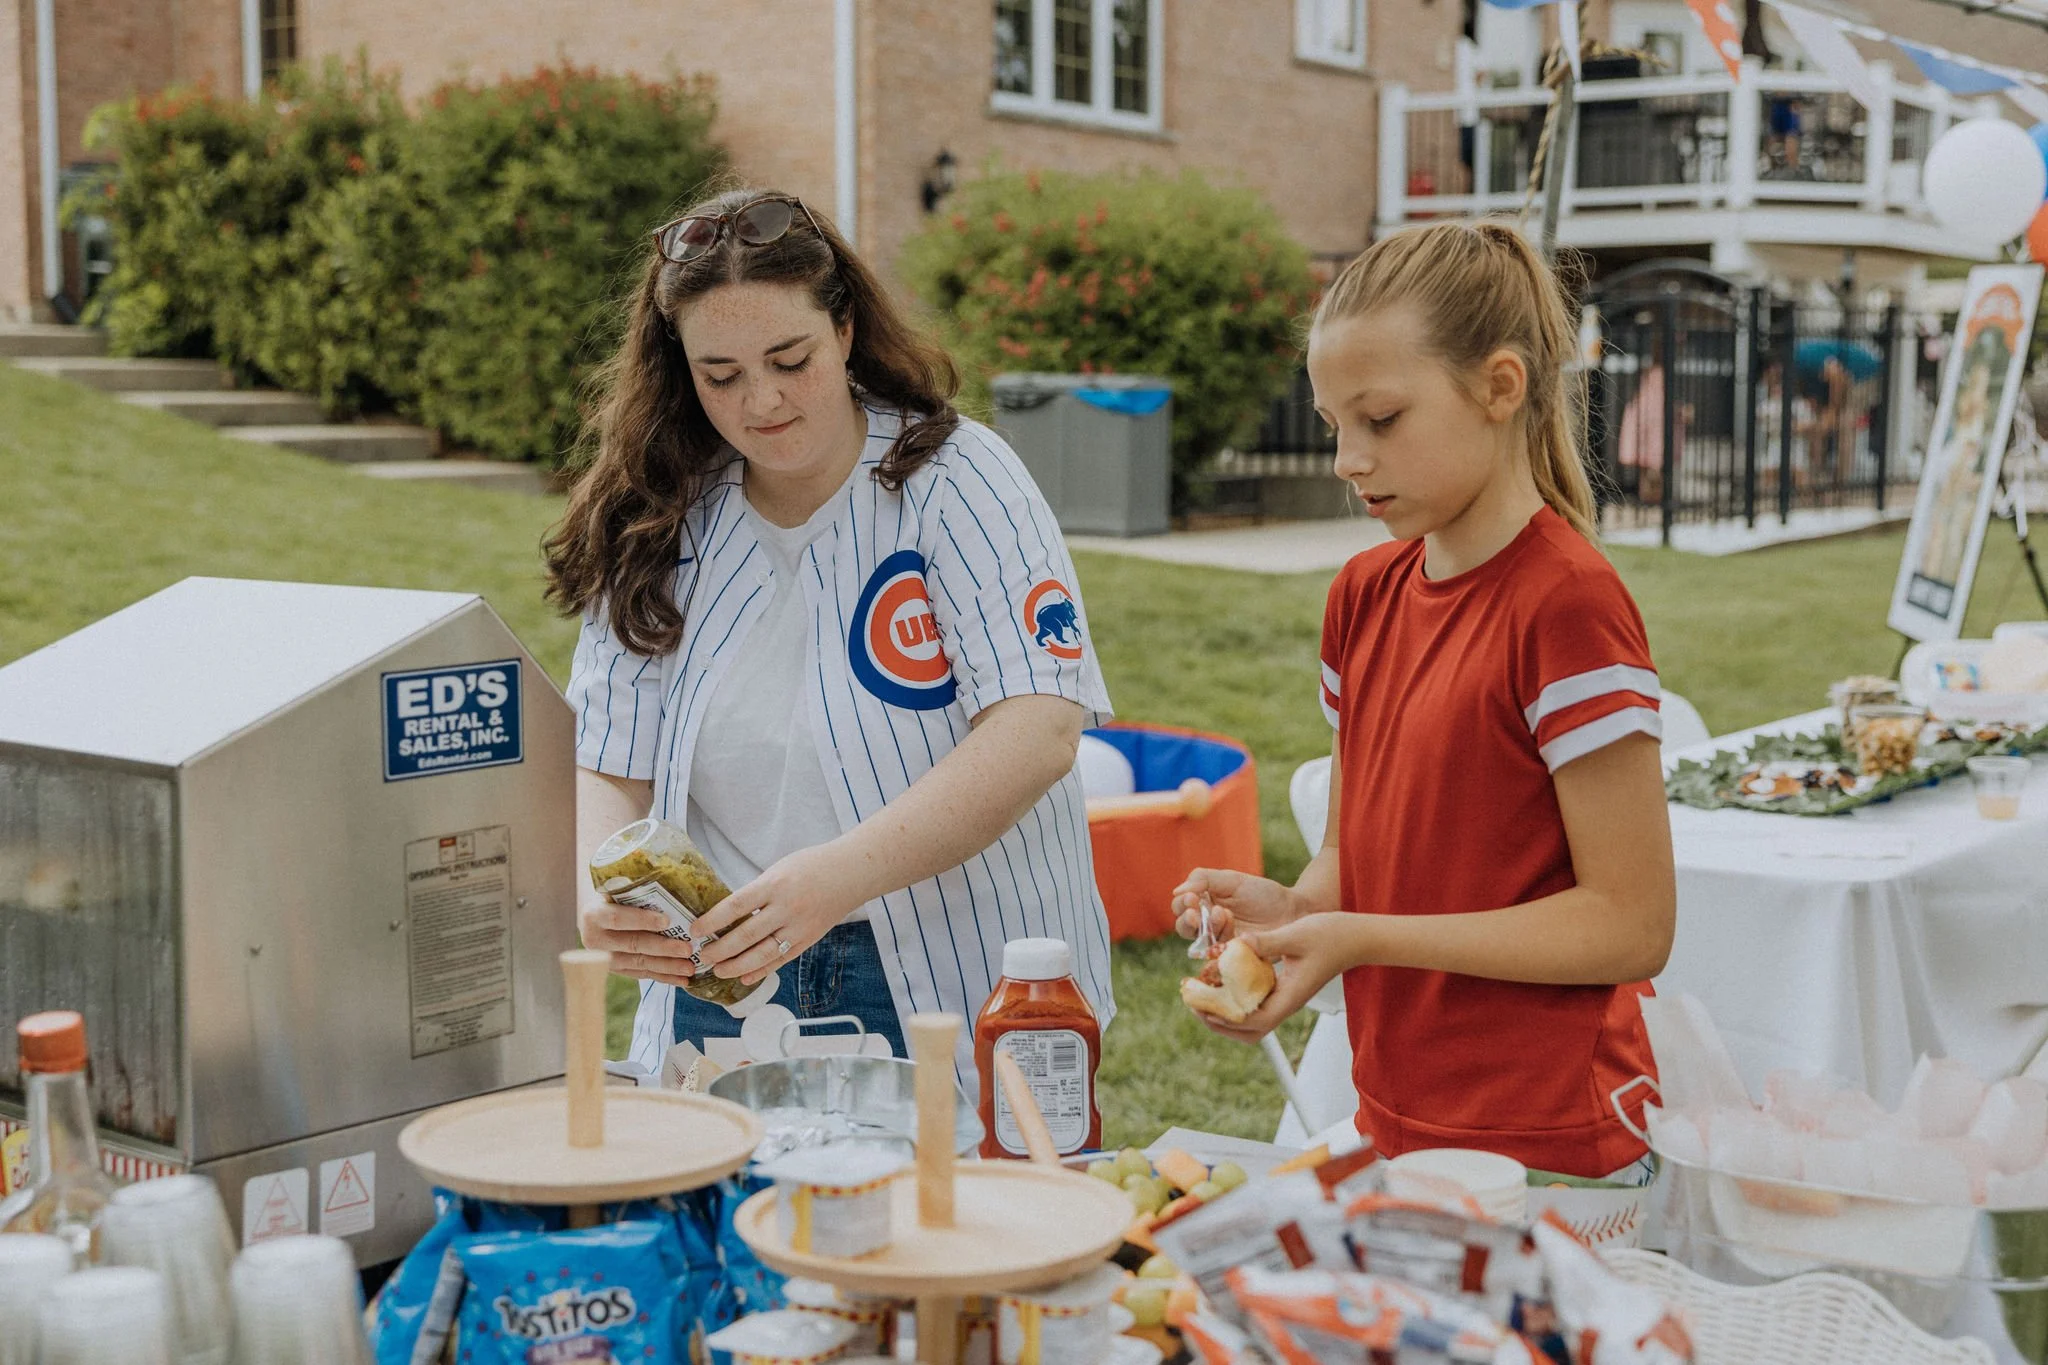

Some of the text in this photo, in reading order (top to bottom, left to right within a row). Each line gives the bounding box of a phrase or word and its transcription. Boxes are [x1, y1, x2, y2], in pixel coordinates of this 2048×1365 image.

[396, 670, 509, 719] ED'S
[404, 709, 504, 737] RENTAL &
[398, 726, 510, 757] SALES, INC.
